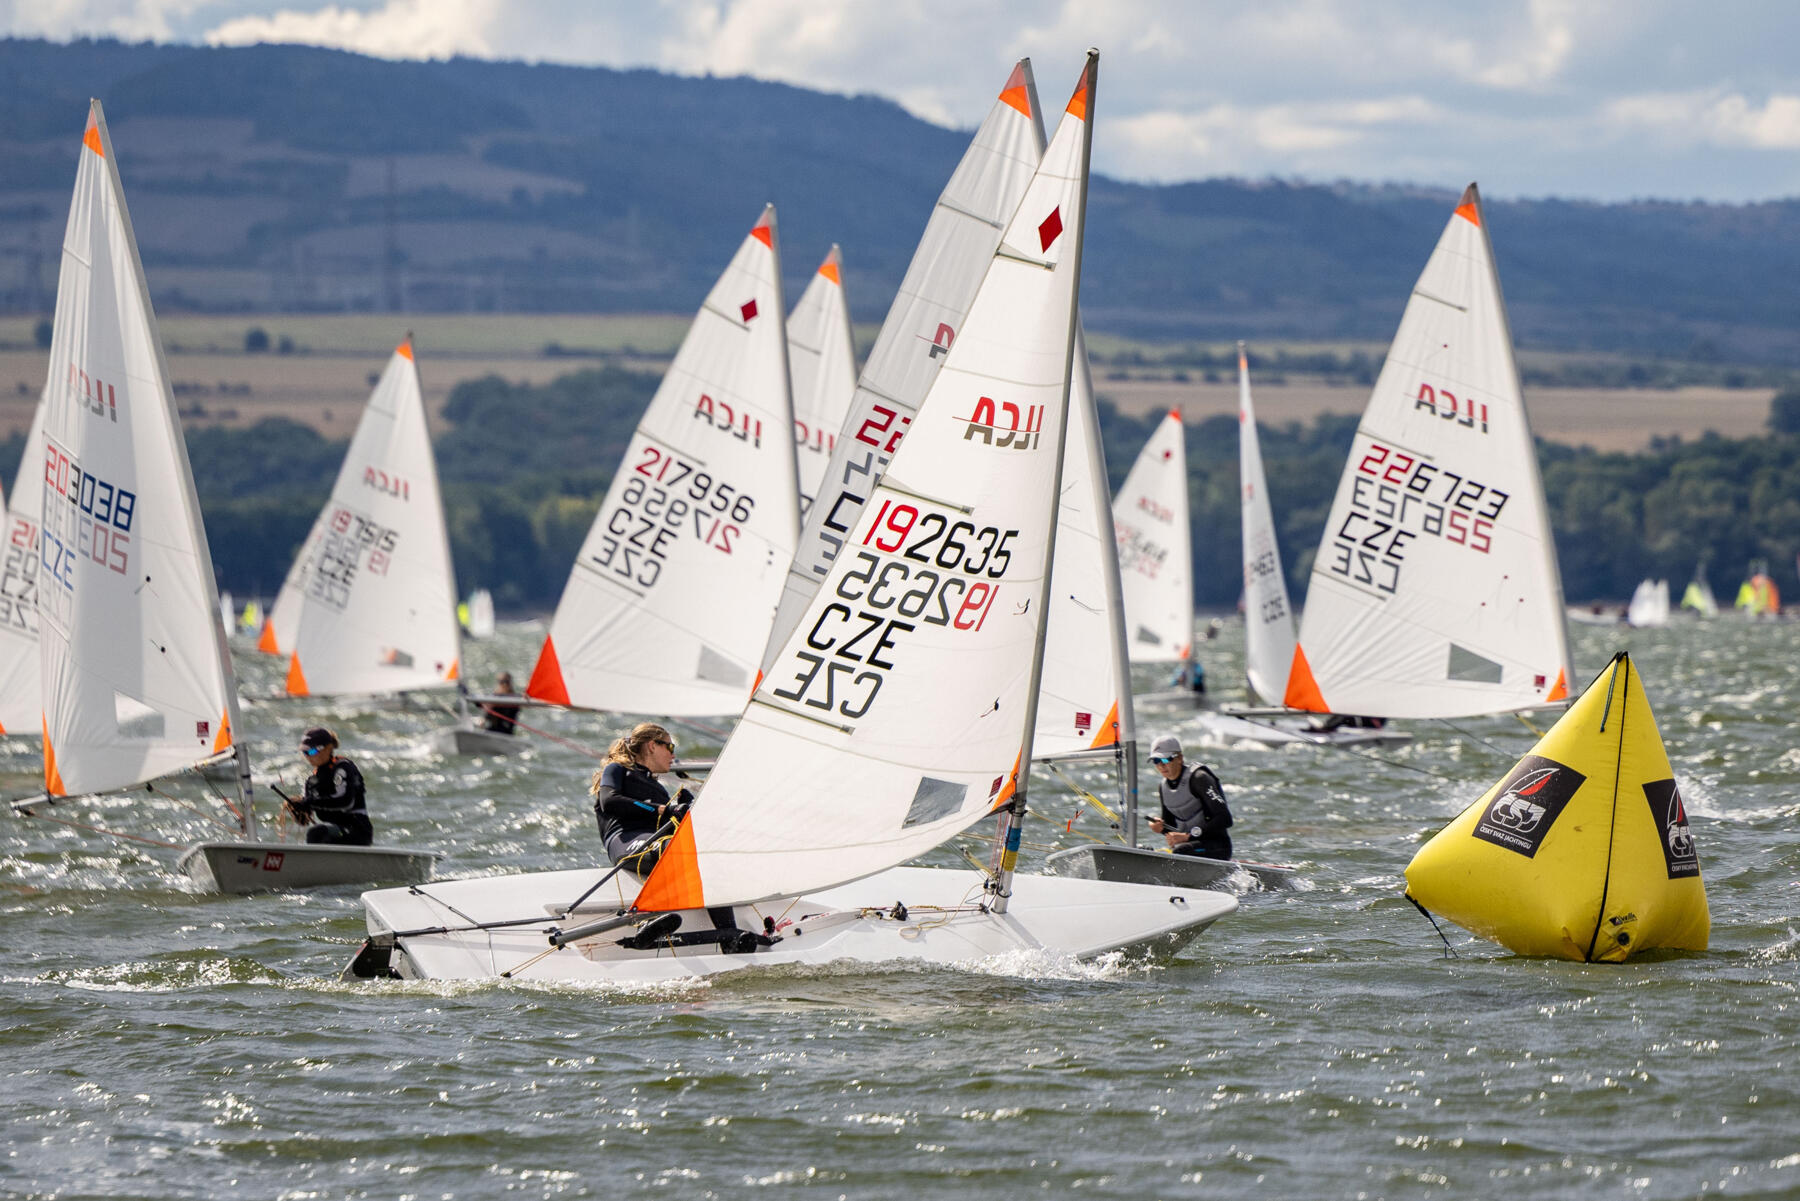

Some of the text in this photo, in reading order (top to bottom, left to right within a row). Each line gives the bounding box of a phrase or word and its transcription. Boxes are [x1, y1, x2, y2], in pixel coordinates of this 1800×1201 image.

[45, 443, 136, 532] 203038
[635, 447, 755, 524] 217956
[1358, 444, 1510, 521] 226723
[43, 528, 76, 592] CZE
[608, 508, 679, 560] CZE
[862, 499, 1019, 578] 192635
[1337, 511, 1417, 560] CZE
[1, 570, 38, 606] CZ
[807, 602, 916, 671] CZE
